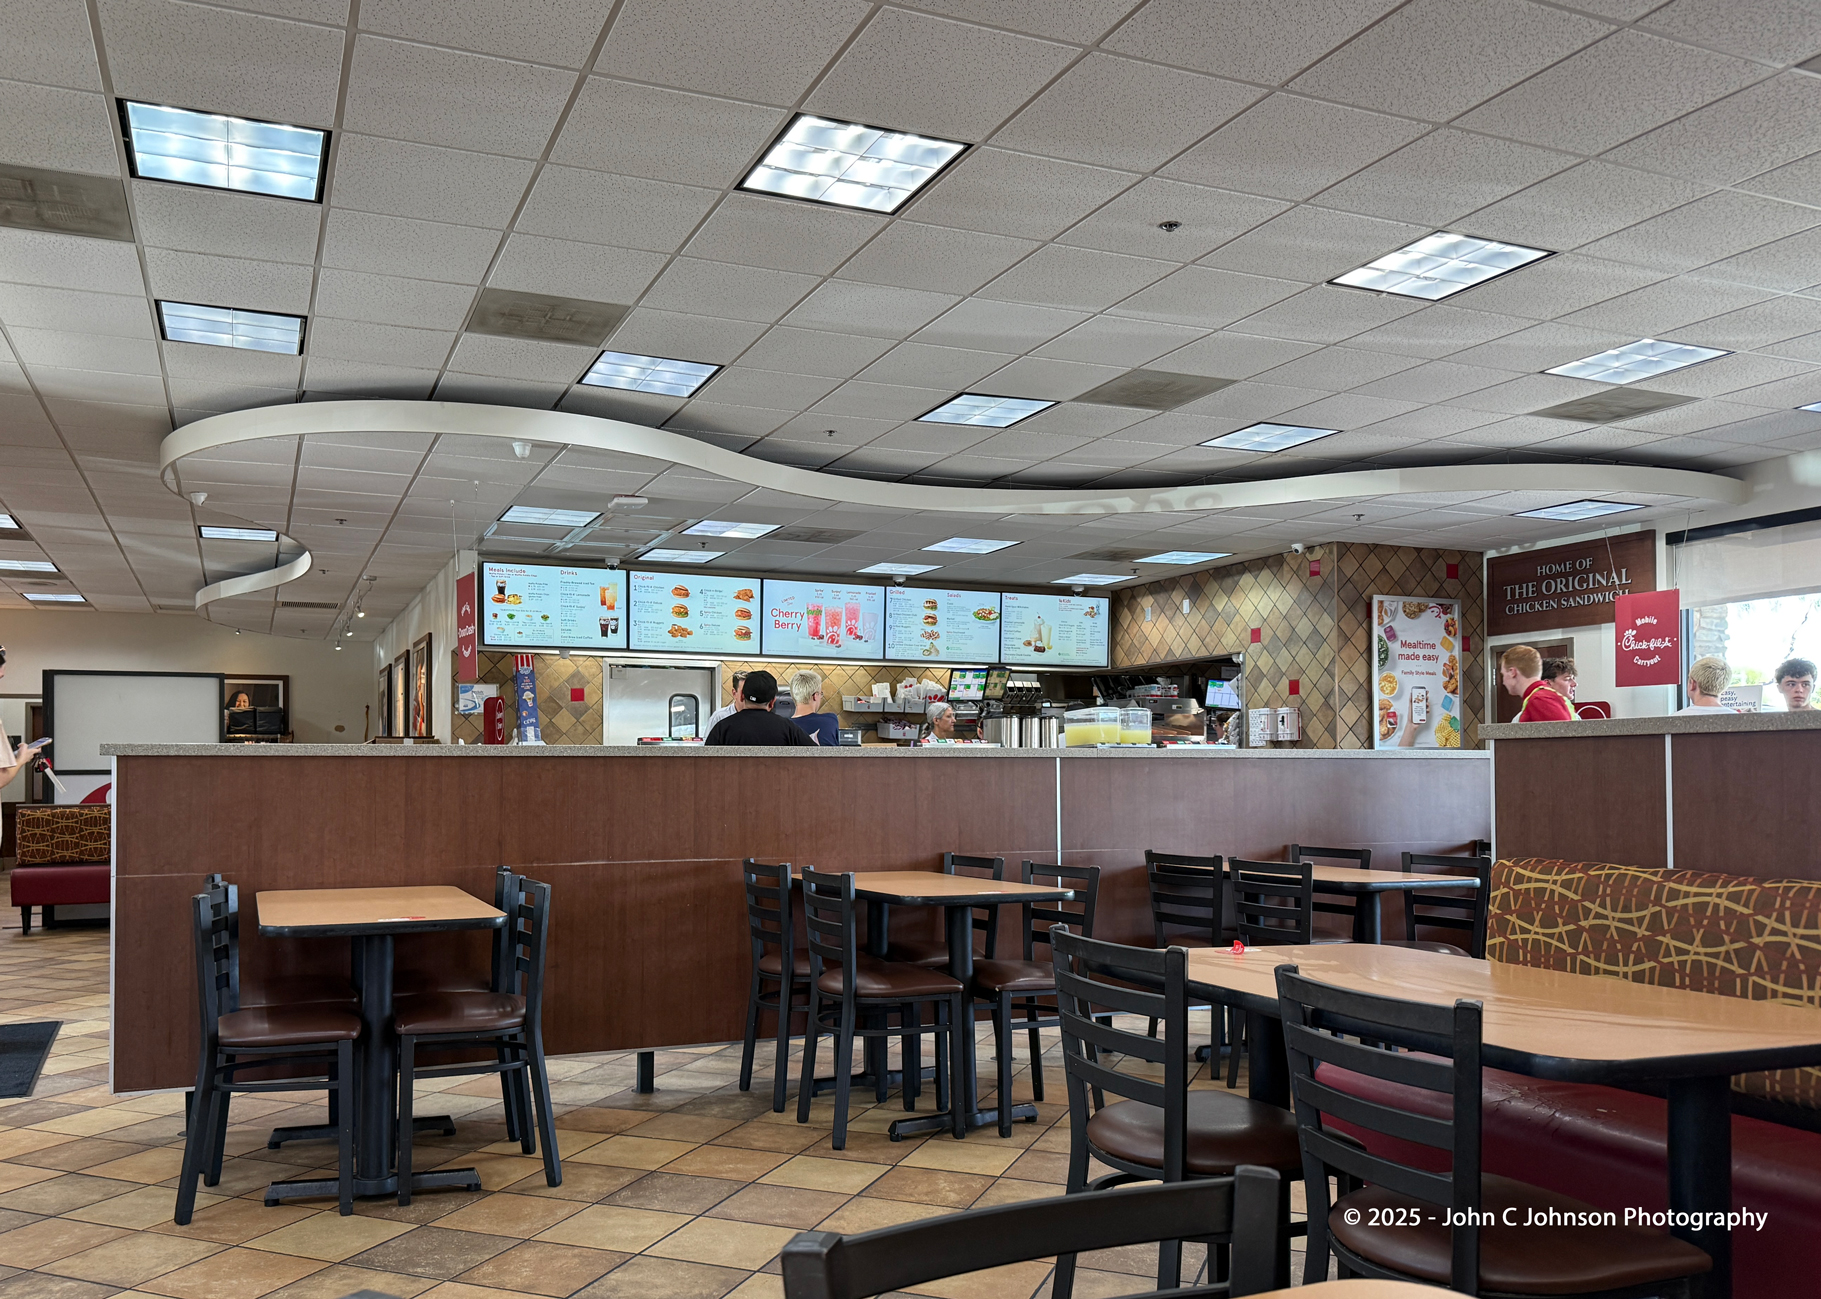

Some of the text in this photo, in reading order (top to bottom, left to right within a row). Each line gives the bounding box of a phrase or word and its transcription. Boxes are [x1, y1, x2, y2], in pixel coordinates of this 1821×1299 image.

[1537, 558, 1593, 576] HOME OF
[1504, 568, 1631, 600] THE ORIGINAL
[1506, 599, 1558, 615] CHICKEN
[771, 608, 805, 620] Cherry
[774, 620, 801, 632] Berry
[1635, 616, 1657, 626] Mobile
[1400, 640, 1436, 650] Mealtime
[1398, 652, 1439, 663] made easy
[1633, 655, 1661, 667] Carryout
